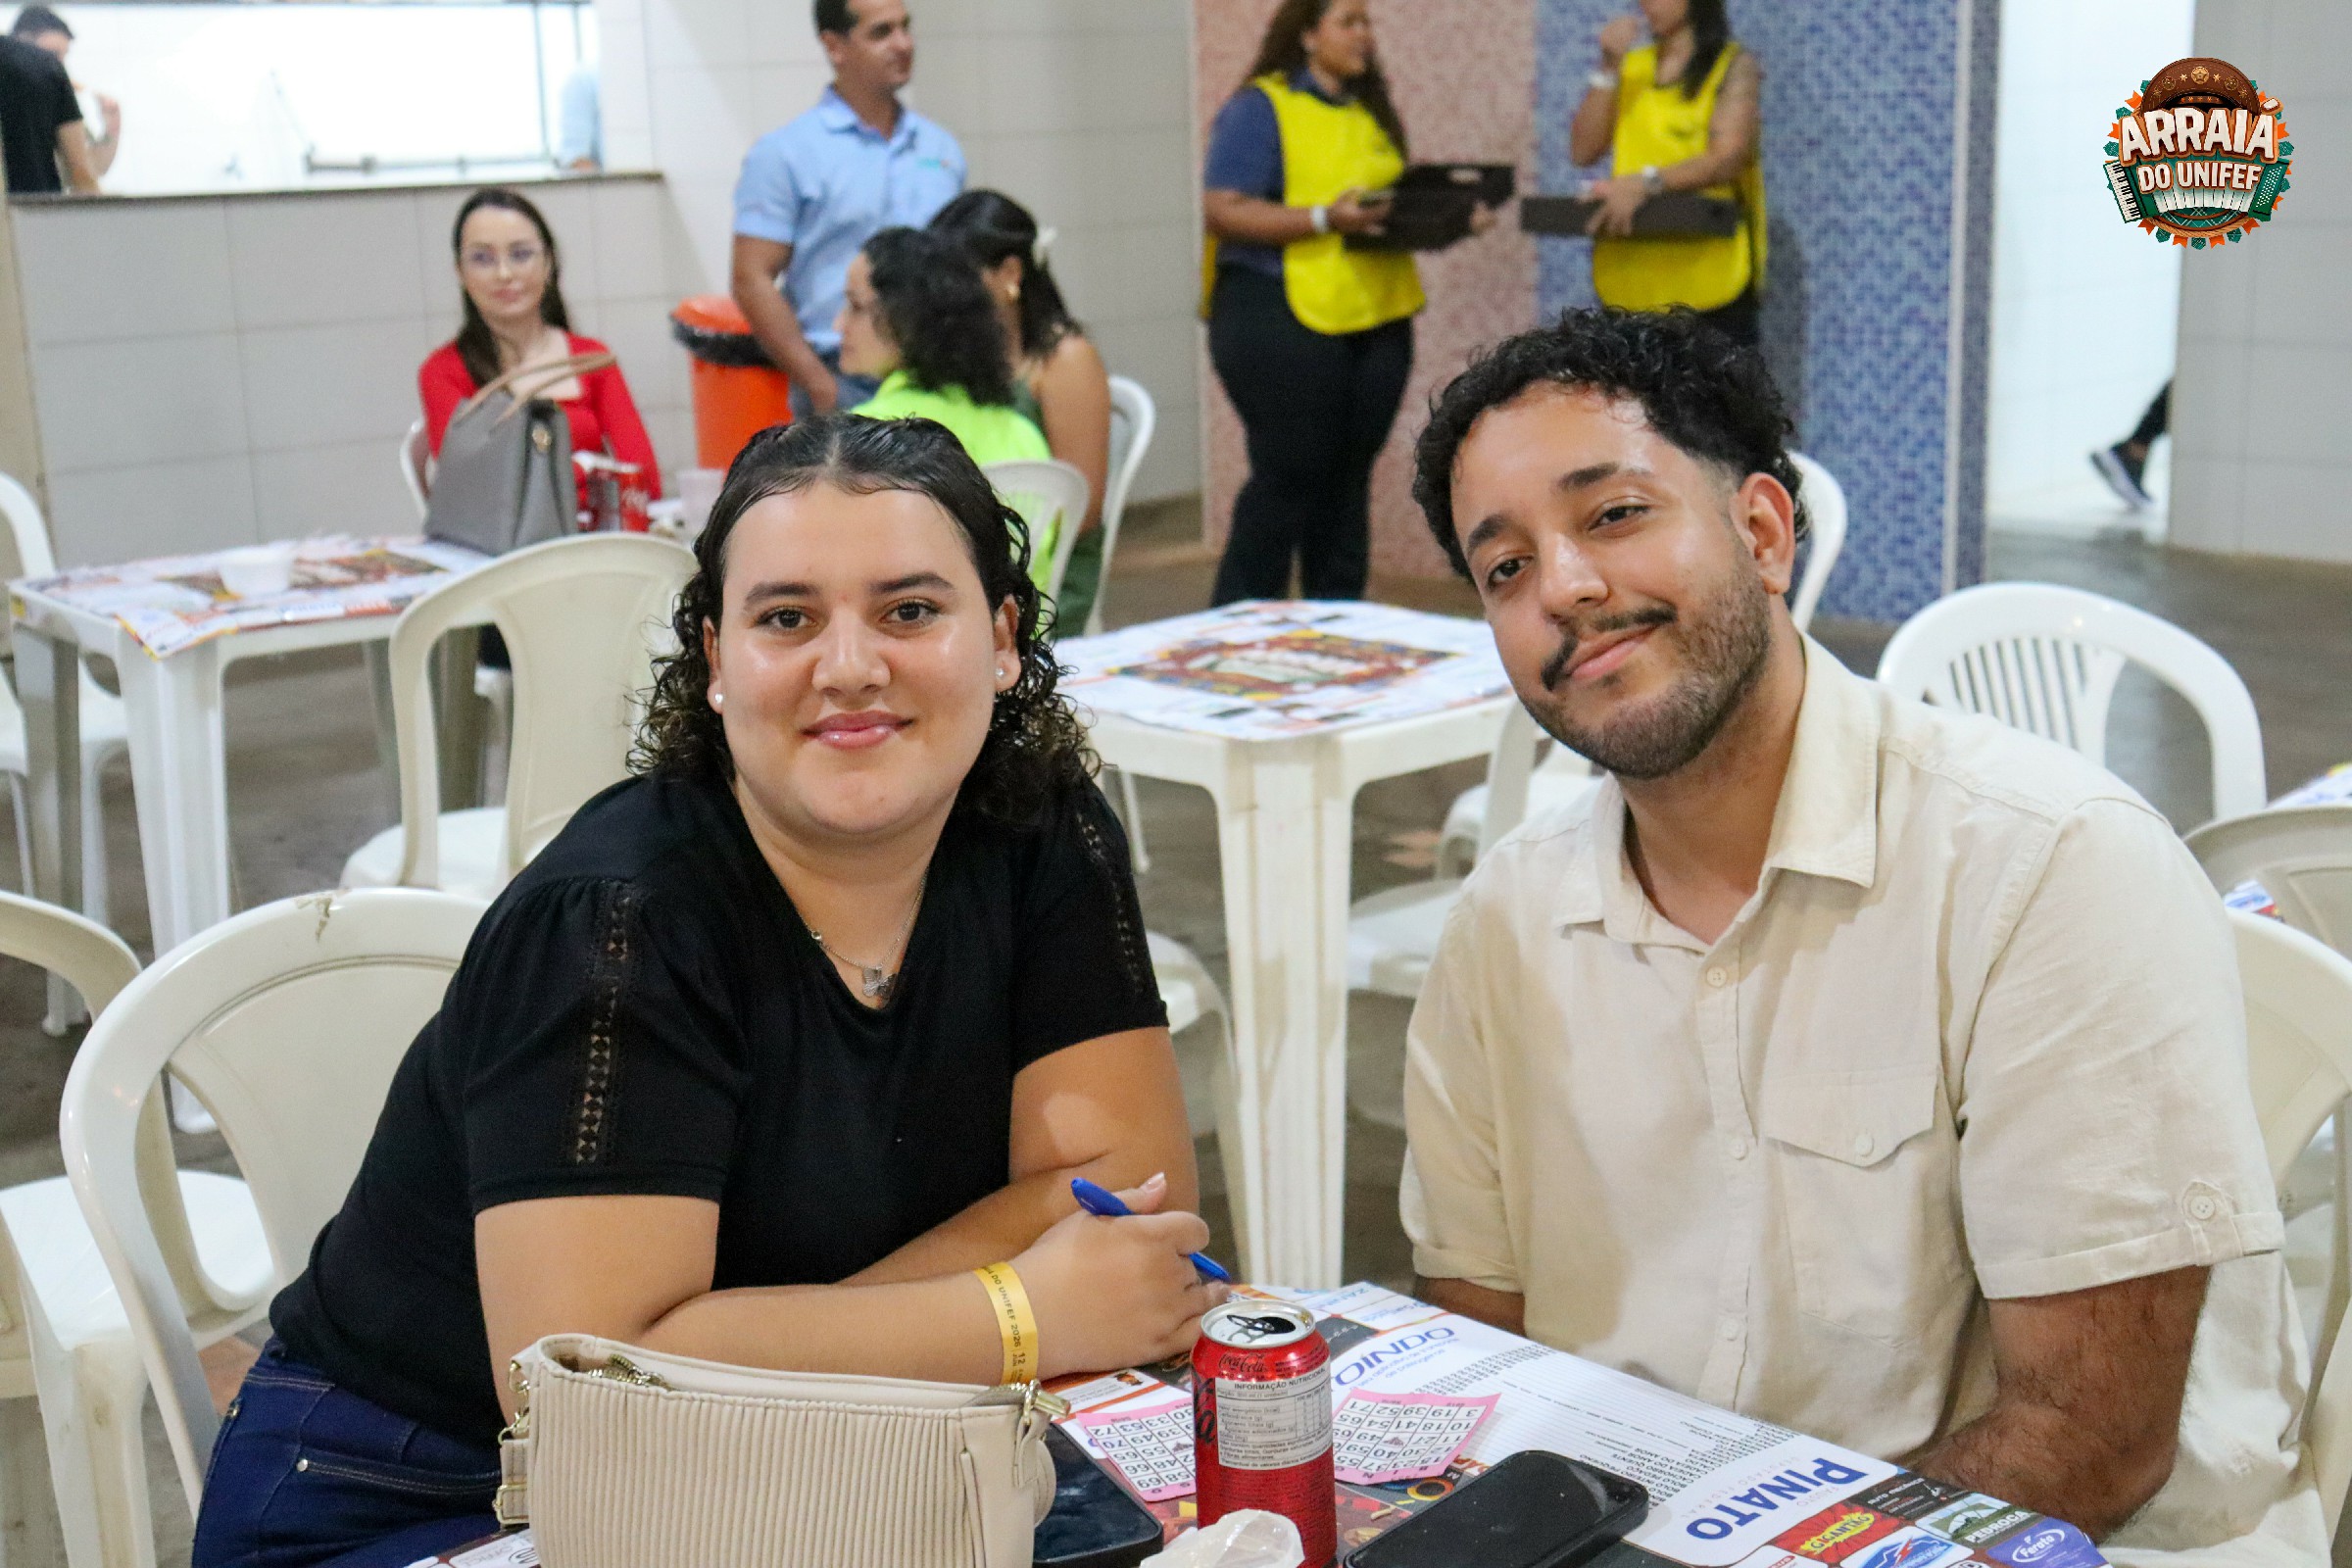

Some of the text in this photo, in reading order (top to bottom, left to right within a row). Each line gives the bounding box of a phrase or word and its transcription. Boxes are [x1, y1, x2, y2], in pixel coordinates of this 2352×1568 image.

[991, 1274, 1021, 1348] DO UNIFEF 2026
[1333, 1327, 1455, 1386] OINDO
[1234, 1382, 1287, 1392] INFORMAÇÃO
[1348, 1400, 1372, 1412] 71
[1377, 1406, 1400, 1415] 52
[1403, 1406, 1427, 1416] 39
[1432, 1408, 1453, 1417] 19
[1466, 1408, 1478, 1417] 3
[1146, 1415, 1171, 1428] 33
[1339, 1413, 1471, 1433] 10 18 41 54 65
[1093, 1426, 1117, 1437] 72
[1120, 1422, 1145, 1434] 53
[1157, 1427, 1182, 1439] 39
[1130, 1434, 1154, 1446] 49
[1356, 1432, 1381, 1443] 49
[1102, 1439, 1127, 1450] 70
[1333, 1442, 1342, 1450] 6
[1347, 1444, 1371, 1453] 59
[1113, 1446, 1166, 1461] 55 65
[1373, 1448, 1398, 1459] 40
[1153, 1457, 1176, 1469] 48
[1337, 1455, 1360, 1466] 55
[1125, 1462, 1150, 1474] 66
[1137, 1472, 1191, 1489] 58 69
[1686, 1457, 1870, 1541] PINATO
[1964, 1510, 2031, 1544] PEDROCA
